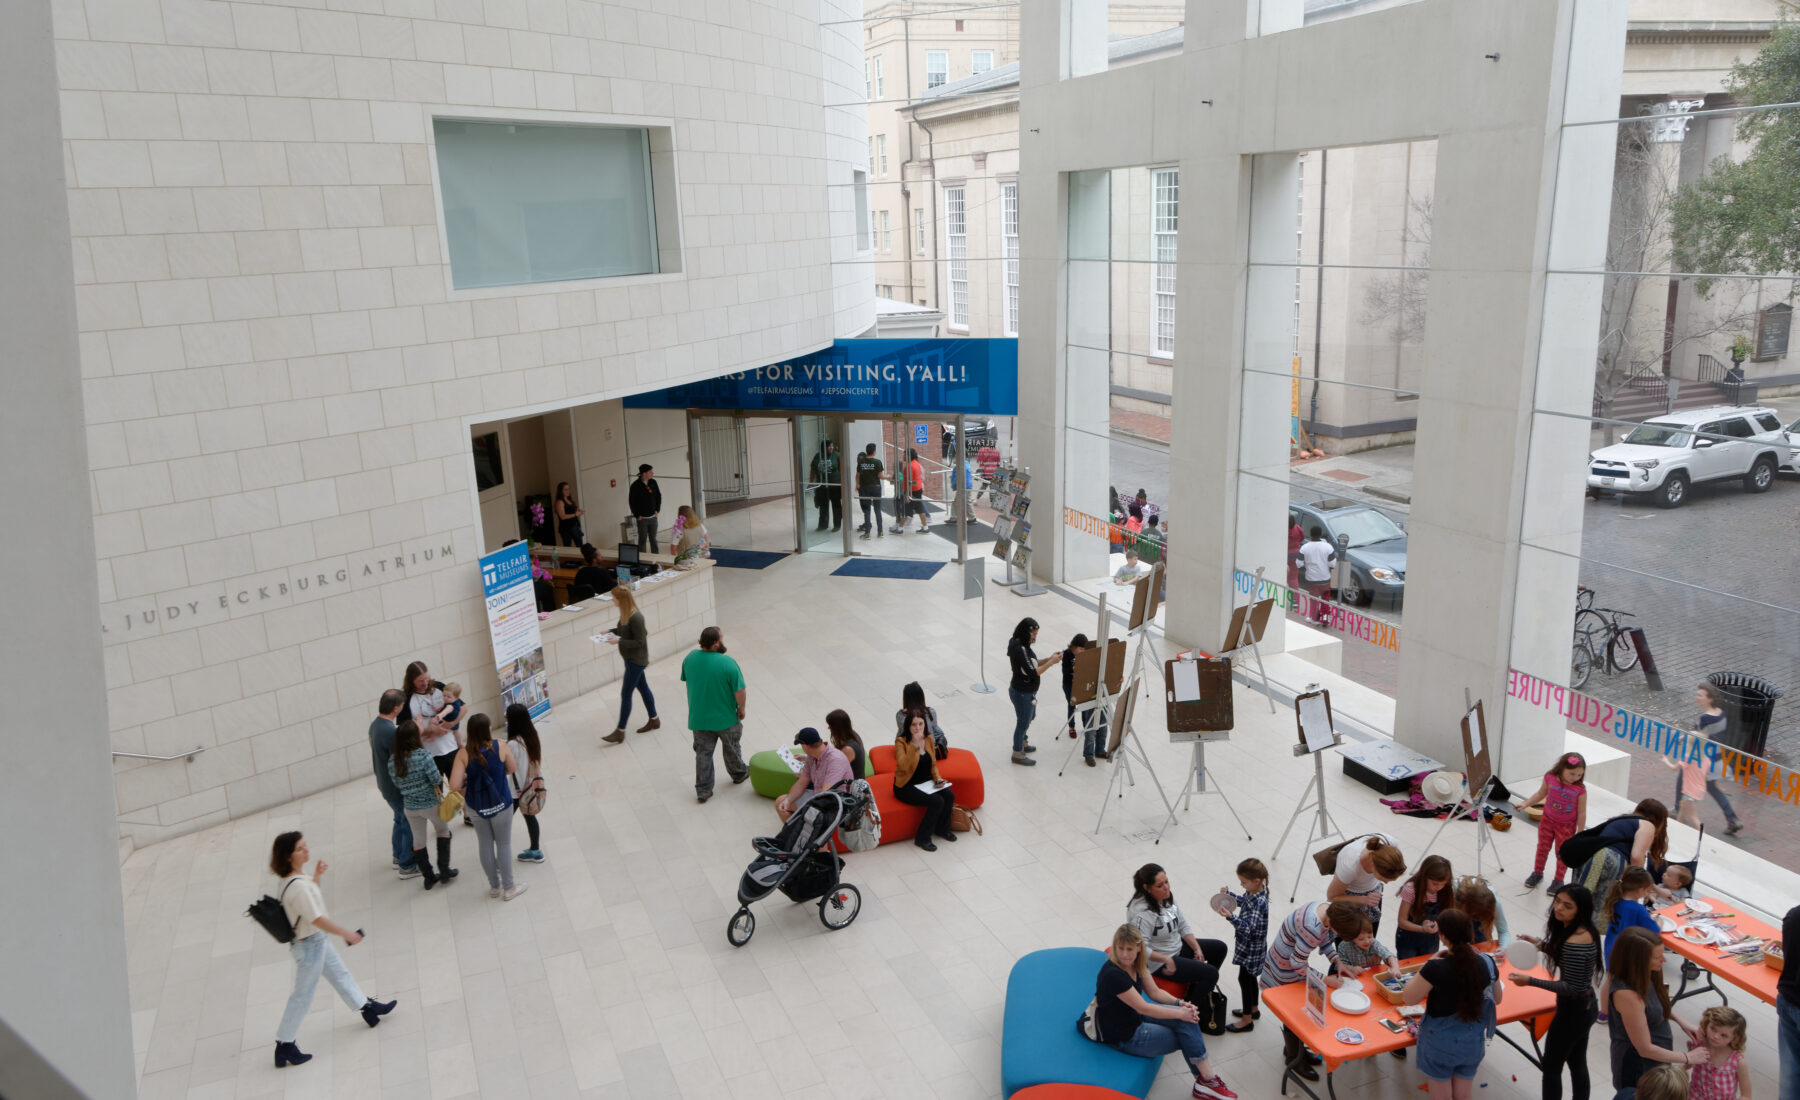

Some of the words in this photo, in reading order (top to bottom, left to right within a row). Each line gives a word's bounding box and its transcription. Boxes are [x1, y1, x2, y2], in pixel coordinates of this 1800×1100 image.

[756, 364, 794, 381] FOR
[803, 364, 902, 384] VISITING,
[906, 364, 966, 382] Y'ALL!
[748, 386, 813, 395] @TELFAIRMUSEUMS
[821, 387, 879, 395] #JEPSONCENTER
[497, 554, 528, 572] TELFAIR
[499, 563, 529, 580] MUSEUMS
[125, 600, 199, 631] JUDY
[218, 568, 347, 609] ECKBURG
[362, 544, 453, 577] ATRIUM
[487, 593, 508, 610] JOIN!
